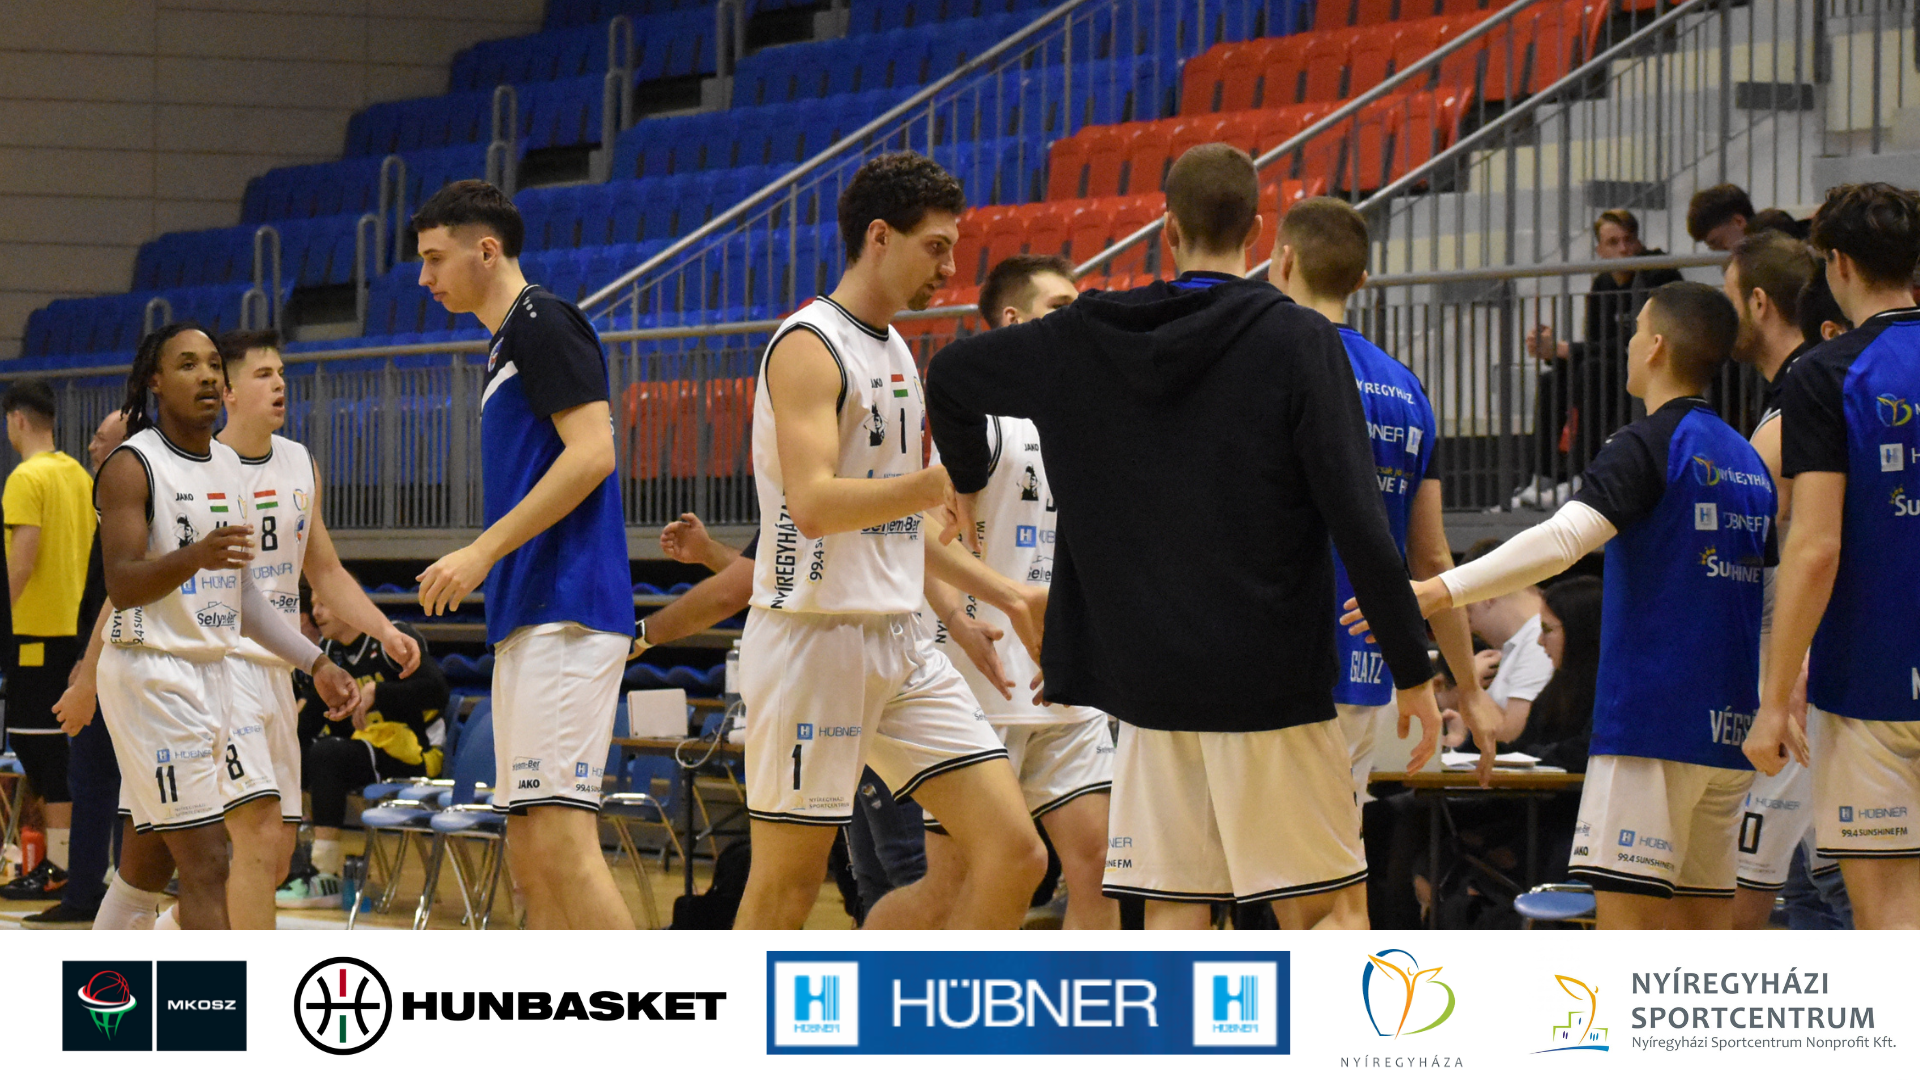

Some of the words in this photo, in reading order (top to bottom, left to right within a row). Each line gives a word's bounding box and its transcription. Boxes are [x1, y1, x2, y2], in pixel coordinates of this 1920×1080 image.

[900, 407, 907, 454] 1
[175, 492, 194, 502] JAKO
[261, 515, 278, 552] 8
[818, 726, 862, 738] HÜBNER
[225, 743, 245, 781] 8
[791, 744, 802, 791] 1
[155, 764, 179, 804] 11
[518, 778, 541, 790] JAKO
[575, 783, 590, 793] 99.4
[1858, 806, 1908, 819] HÜBNER
[1738, 811, 1763, 855] 0
[1118, 859, 1133, 869] FM
